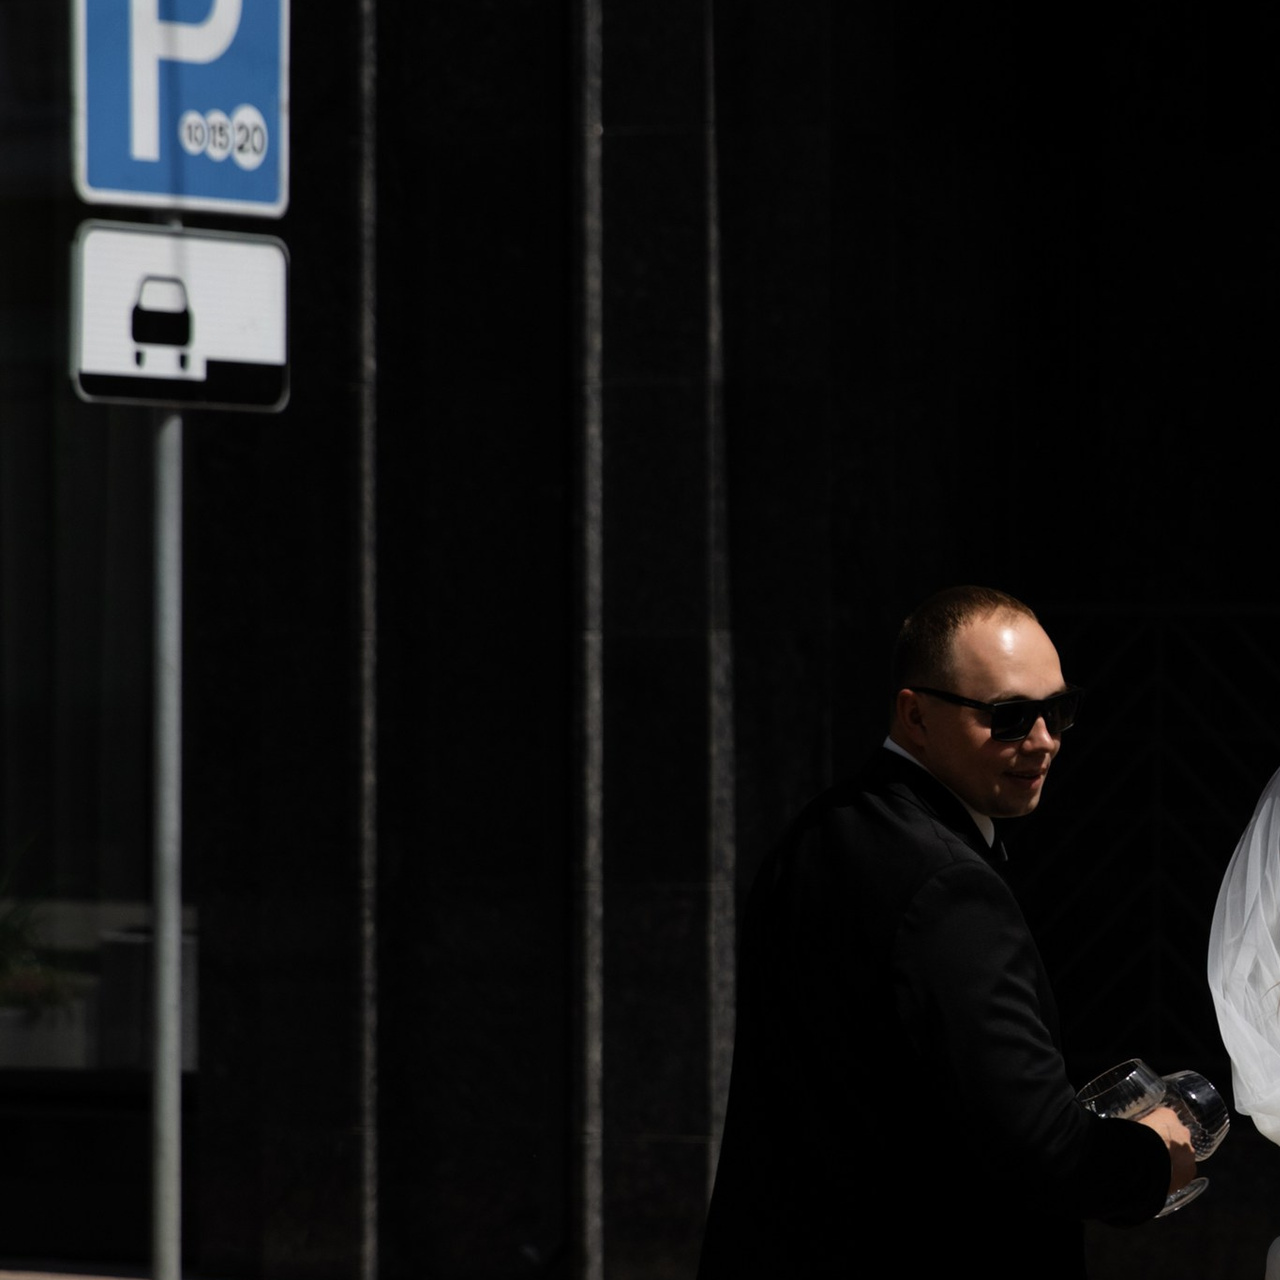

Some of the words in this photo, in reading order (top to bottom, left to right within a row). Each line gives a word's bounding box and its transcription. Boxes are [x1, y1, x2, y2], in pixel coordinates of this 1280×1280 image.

[187, 123, 206, 147] 10
[211, 122, 230, 151] 15
[237, 122, 265, 156] 20
